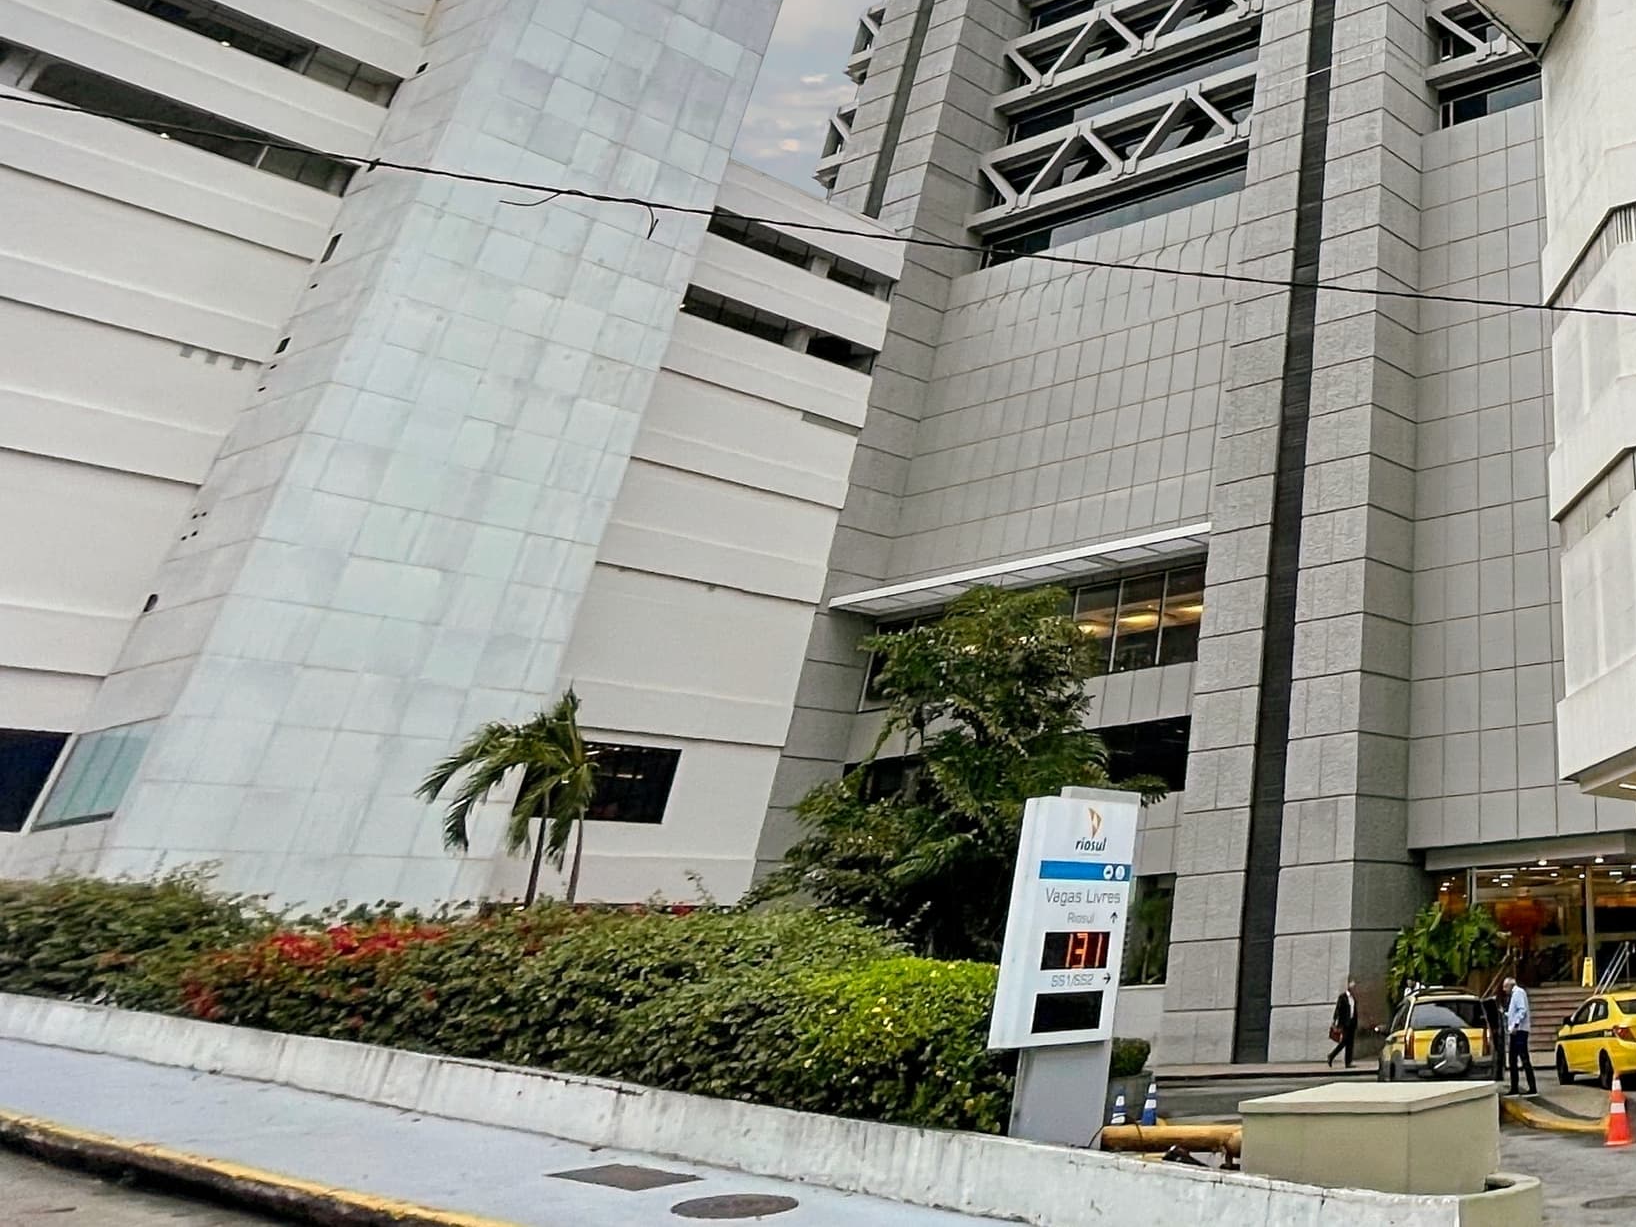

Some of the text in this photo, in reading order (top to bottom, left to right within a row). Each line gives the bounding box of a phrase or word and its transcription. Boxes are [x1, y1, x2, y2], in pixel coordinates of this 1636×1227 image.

[1075, 837, 1107, 852] riosul
[1046, 887, 1121, 906] Vagas Livres
[1067, 912, 1095, 924] Riosul
[1065, 933, 1103, 969] 131
